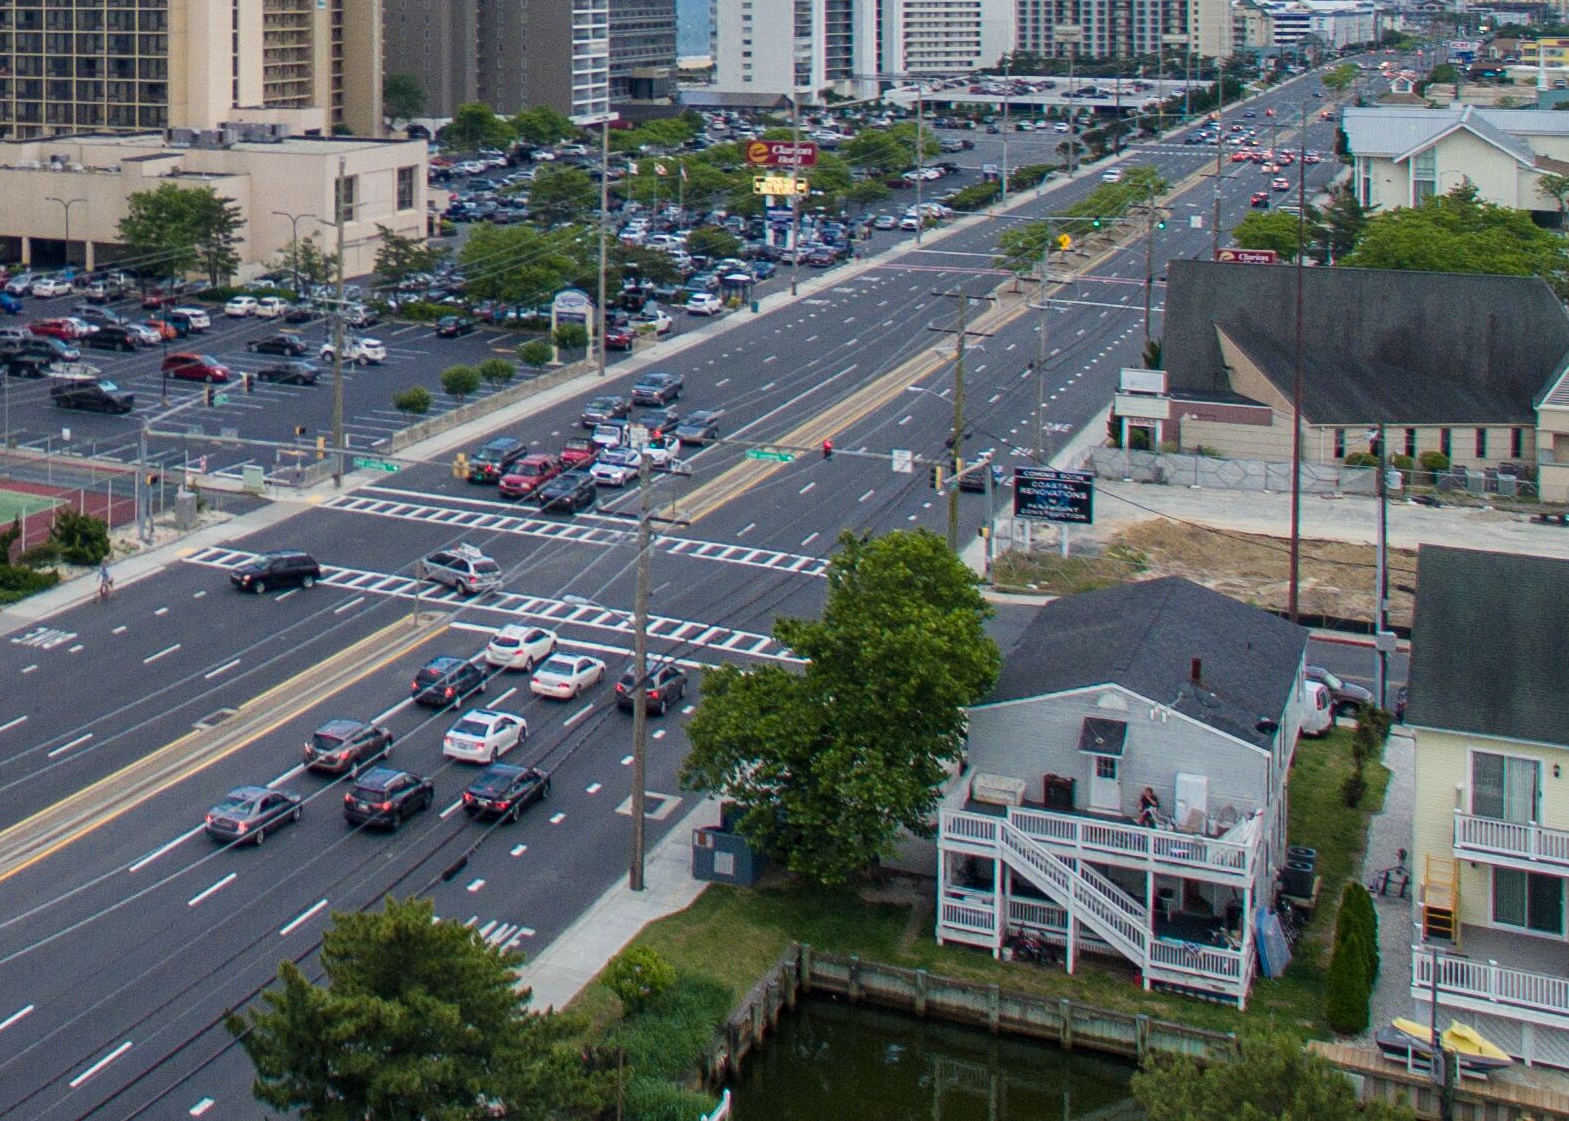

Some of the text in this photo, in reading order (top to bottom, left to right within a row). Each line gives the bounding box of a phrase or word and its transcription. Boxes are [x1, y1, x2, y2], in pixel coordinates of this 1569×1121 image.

[772, 144, 812, 155] Claron
[777, 155, 802, 164] Hotl
[1032, 481, 1075, 490] COASTAL
[1020, 487, 1087, 499] RENOVATIONS
